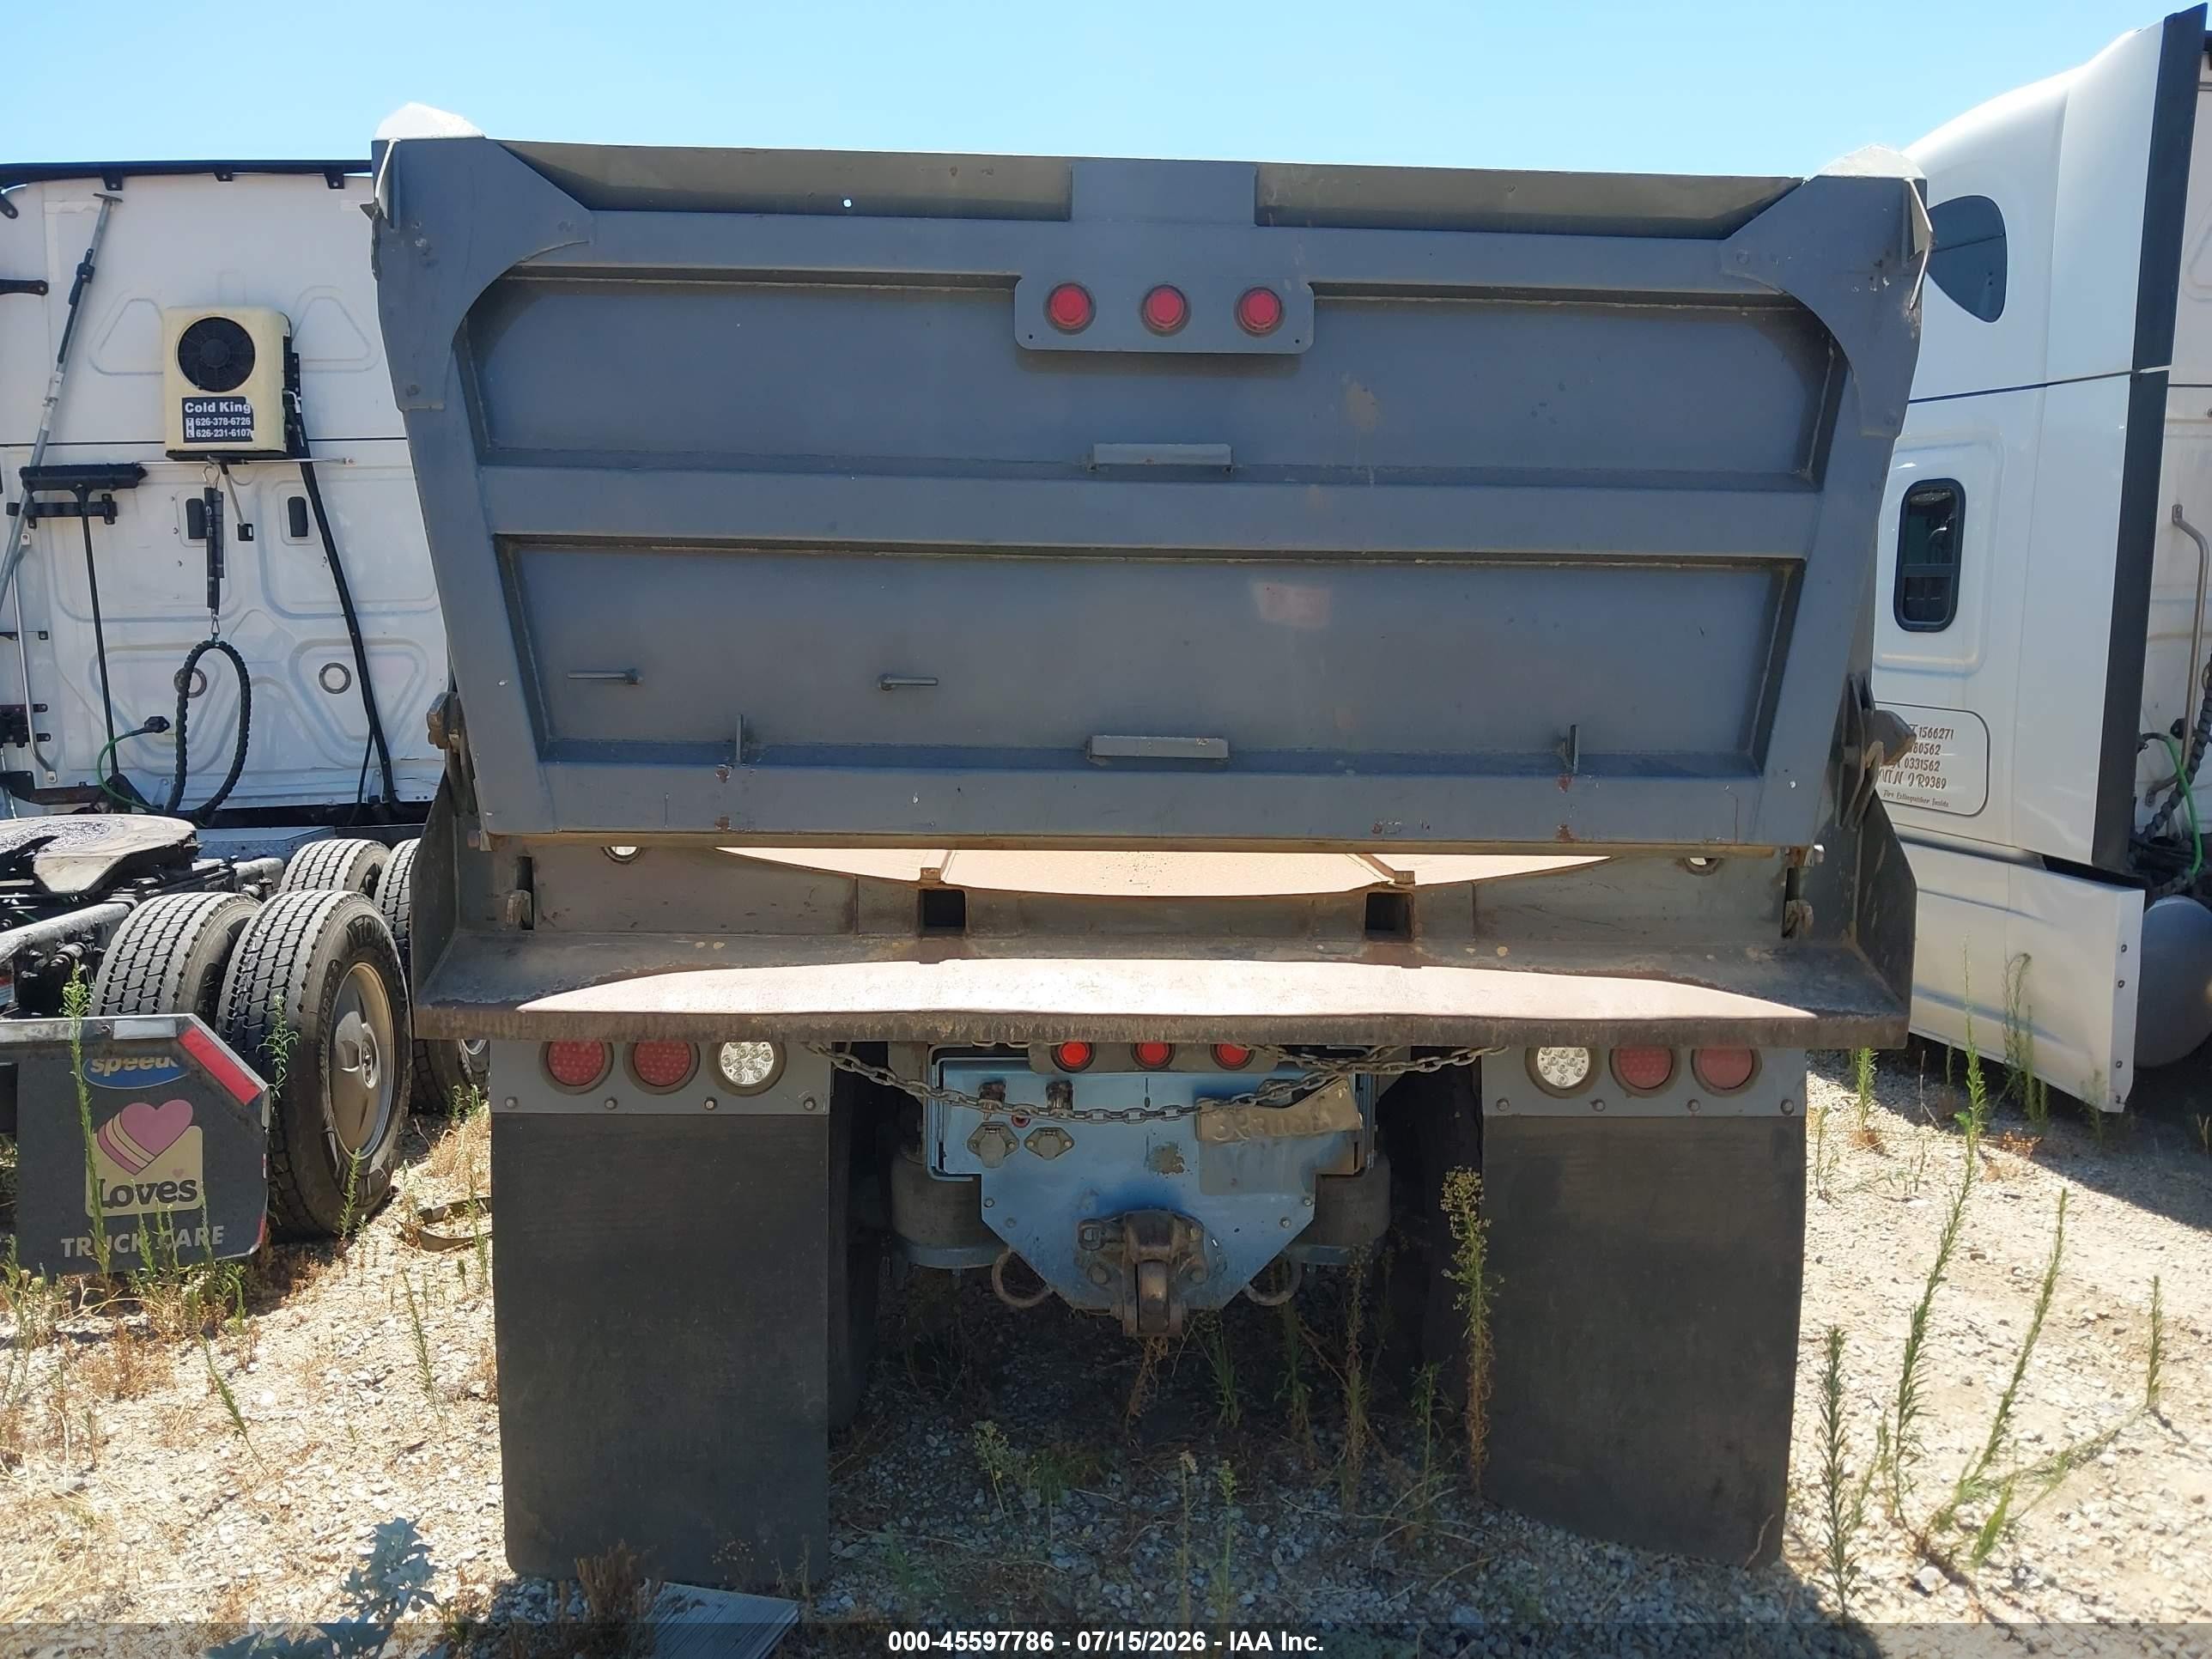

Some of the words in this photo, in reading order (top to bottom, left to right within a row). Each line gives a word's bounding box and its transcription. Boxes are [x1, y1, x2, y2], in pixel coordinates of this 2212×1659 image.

[185, 401, 216, 413] Cold
[219, 401, 252, 414] King
[195, 417, 251, 426] 626-378-6726
[196, 428, 252, 438] 626-231-6107
[1919, 726, 1954, 740] 1566271
[1910, 742, 1942, 756] 80562
[1904, 757, 1941, 772] 0331562
